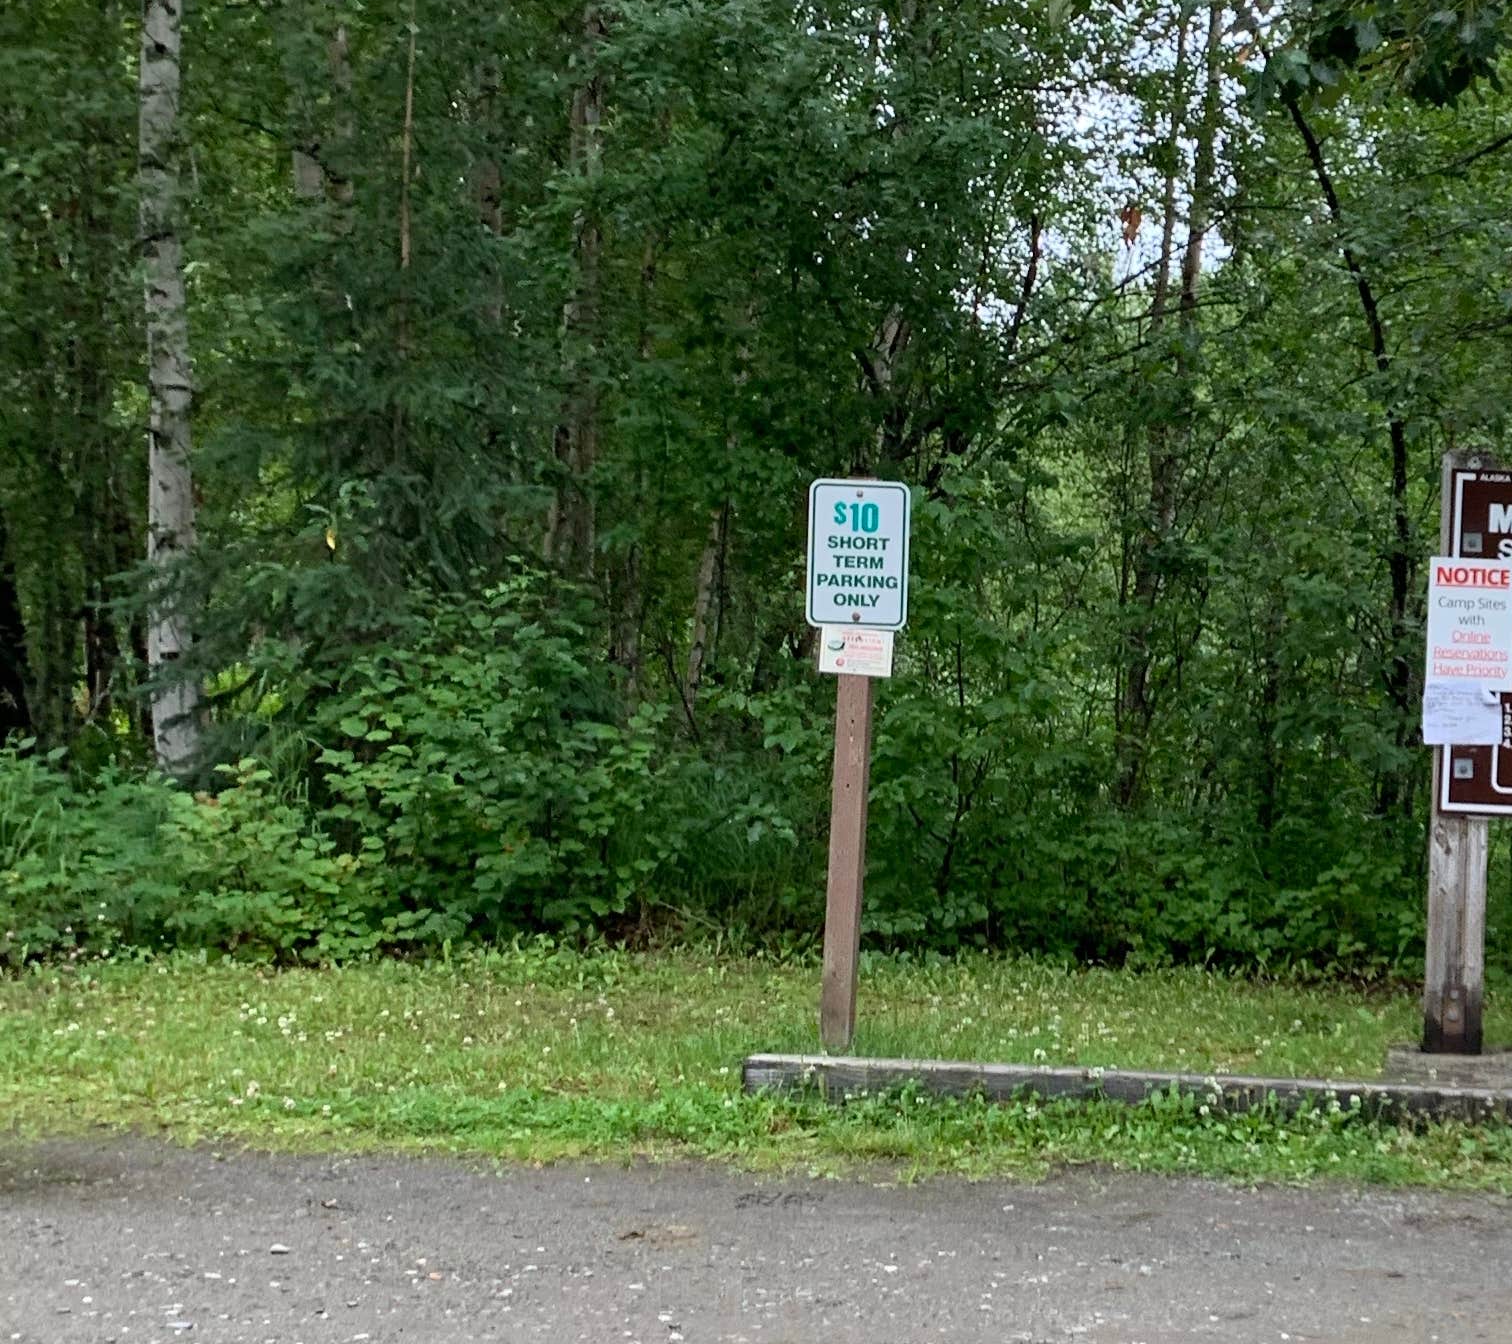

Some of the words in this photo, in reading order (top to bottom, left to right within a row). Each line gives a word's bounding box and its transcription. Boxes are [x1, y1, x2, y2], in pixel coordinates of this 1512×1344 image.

[834, 501, 879, 532] $10
[827, 536, 890, 550] SHORT
[832, 555, 884, 570] TERM
[816, 574, 898, 589] PARKING
[1436, 566, 1511, 586] NOTICE
[833, 593, 880, 608] ONLY
[1438, 596, 1474, 610] Camp
[1478, 598, 1506, 610] Sites
[1458, 614, 1485, 625] with
[1452, 630, 1491, 642] Online
[1433, 646, 1508, 660] Reservations
[1433, 662, 1464, 674] Have
[1466, 664, 1508, 679] Priority
[1504, 704, 1512, 713] 1.
